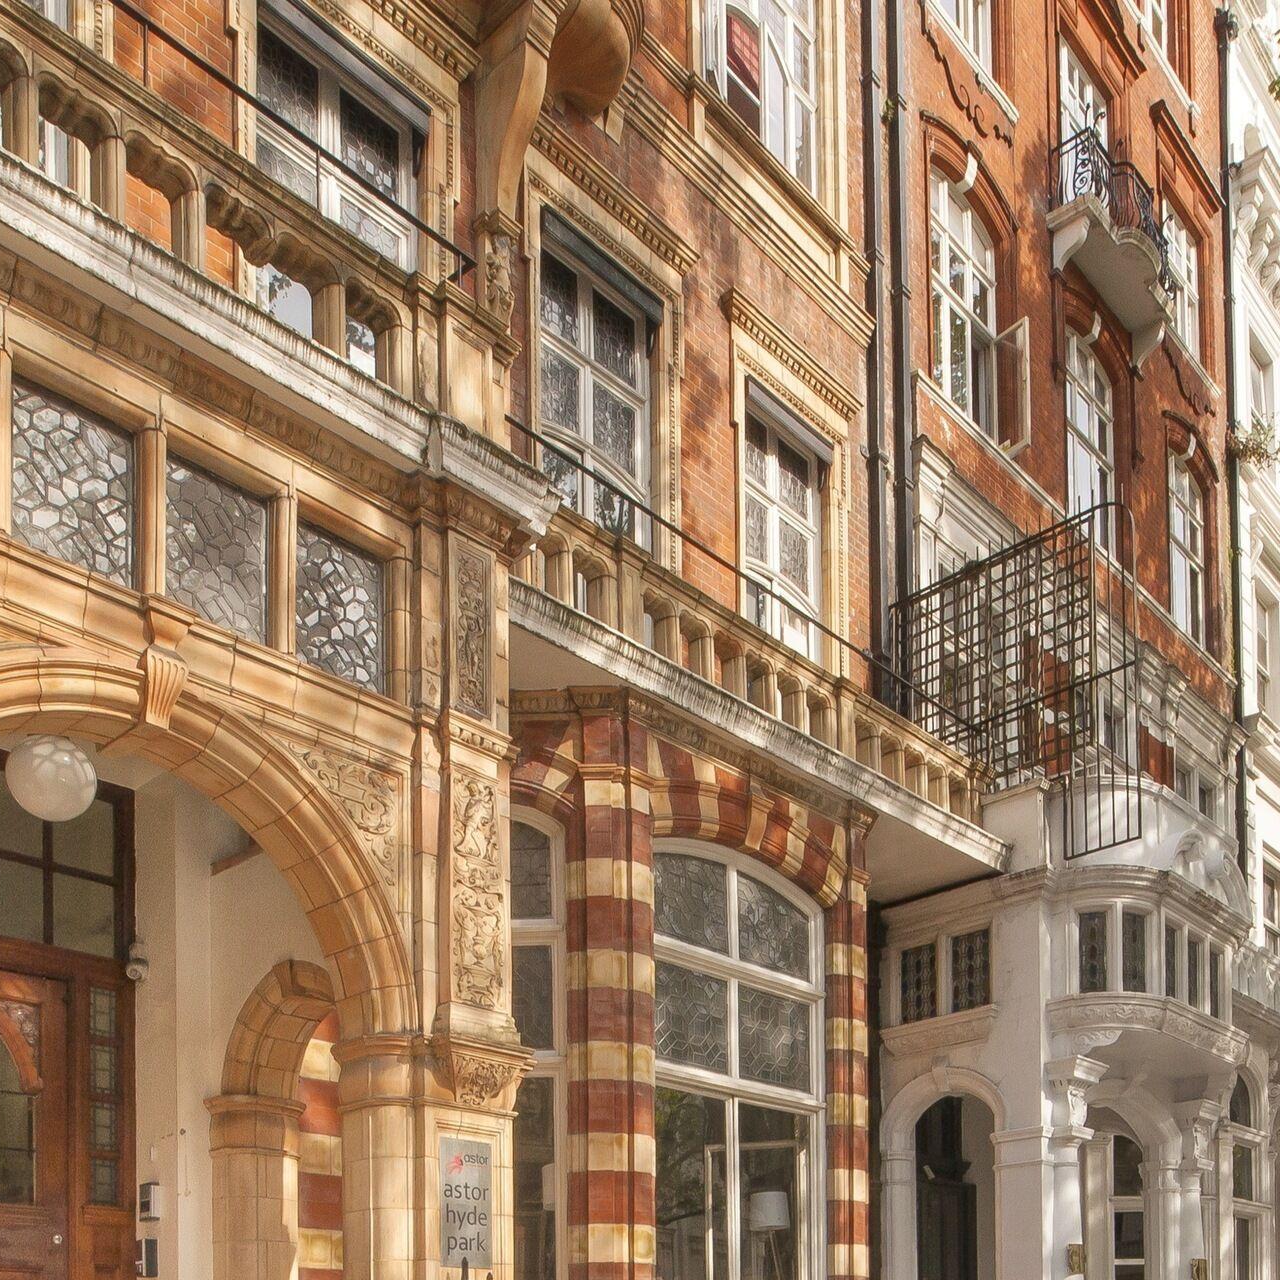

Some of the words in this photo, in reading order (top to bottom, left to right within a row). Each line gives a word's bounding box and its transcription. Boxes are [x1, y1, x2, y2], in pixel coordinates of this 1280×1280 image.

[463, 1153, 489, 1166] astor
[444, 1182, 489, 1201] astor
[446, 1202, 488, 1231] hyde
[447, 1231, 486, 1256] park
